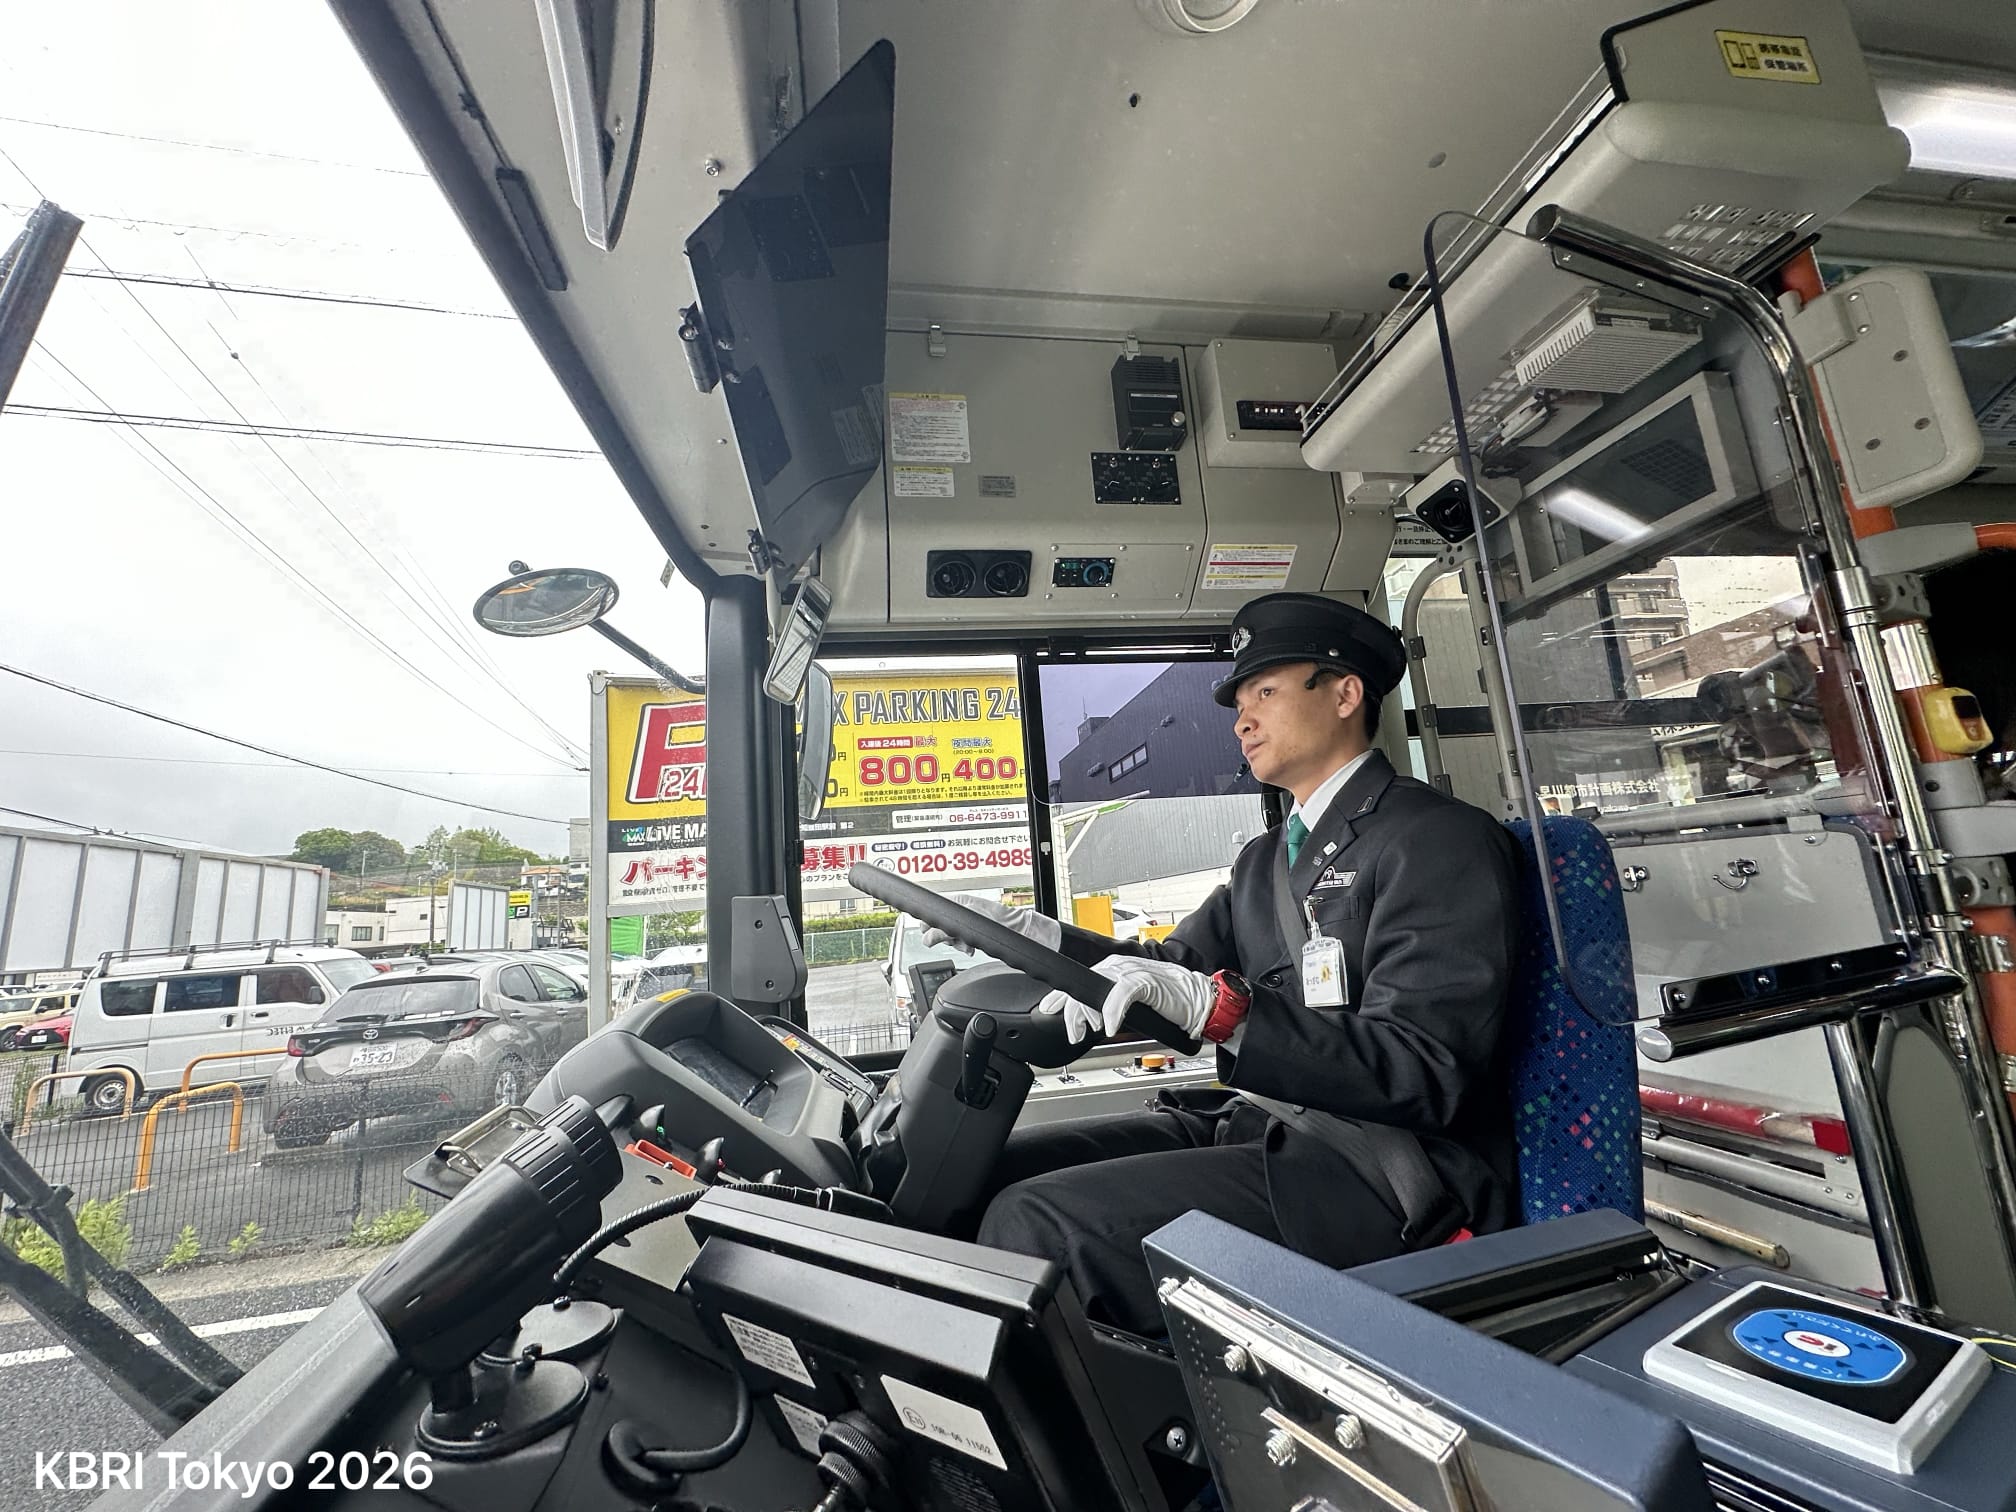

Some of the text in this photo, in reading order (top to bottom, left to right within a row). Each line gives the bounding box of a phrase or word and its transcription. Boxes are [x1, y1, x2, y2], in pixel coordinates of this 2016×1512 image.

[853, 688, 981, 725] PARKING
[985, 687, 1022, 720] 24
[660, 766, 706, 800] 24
